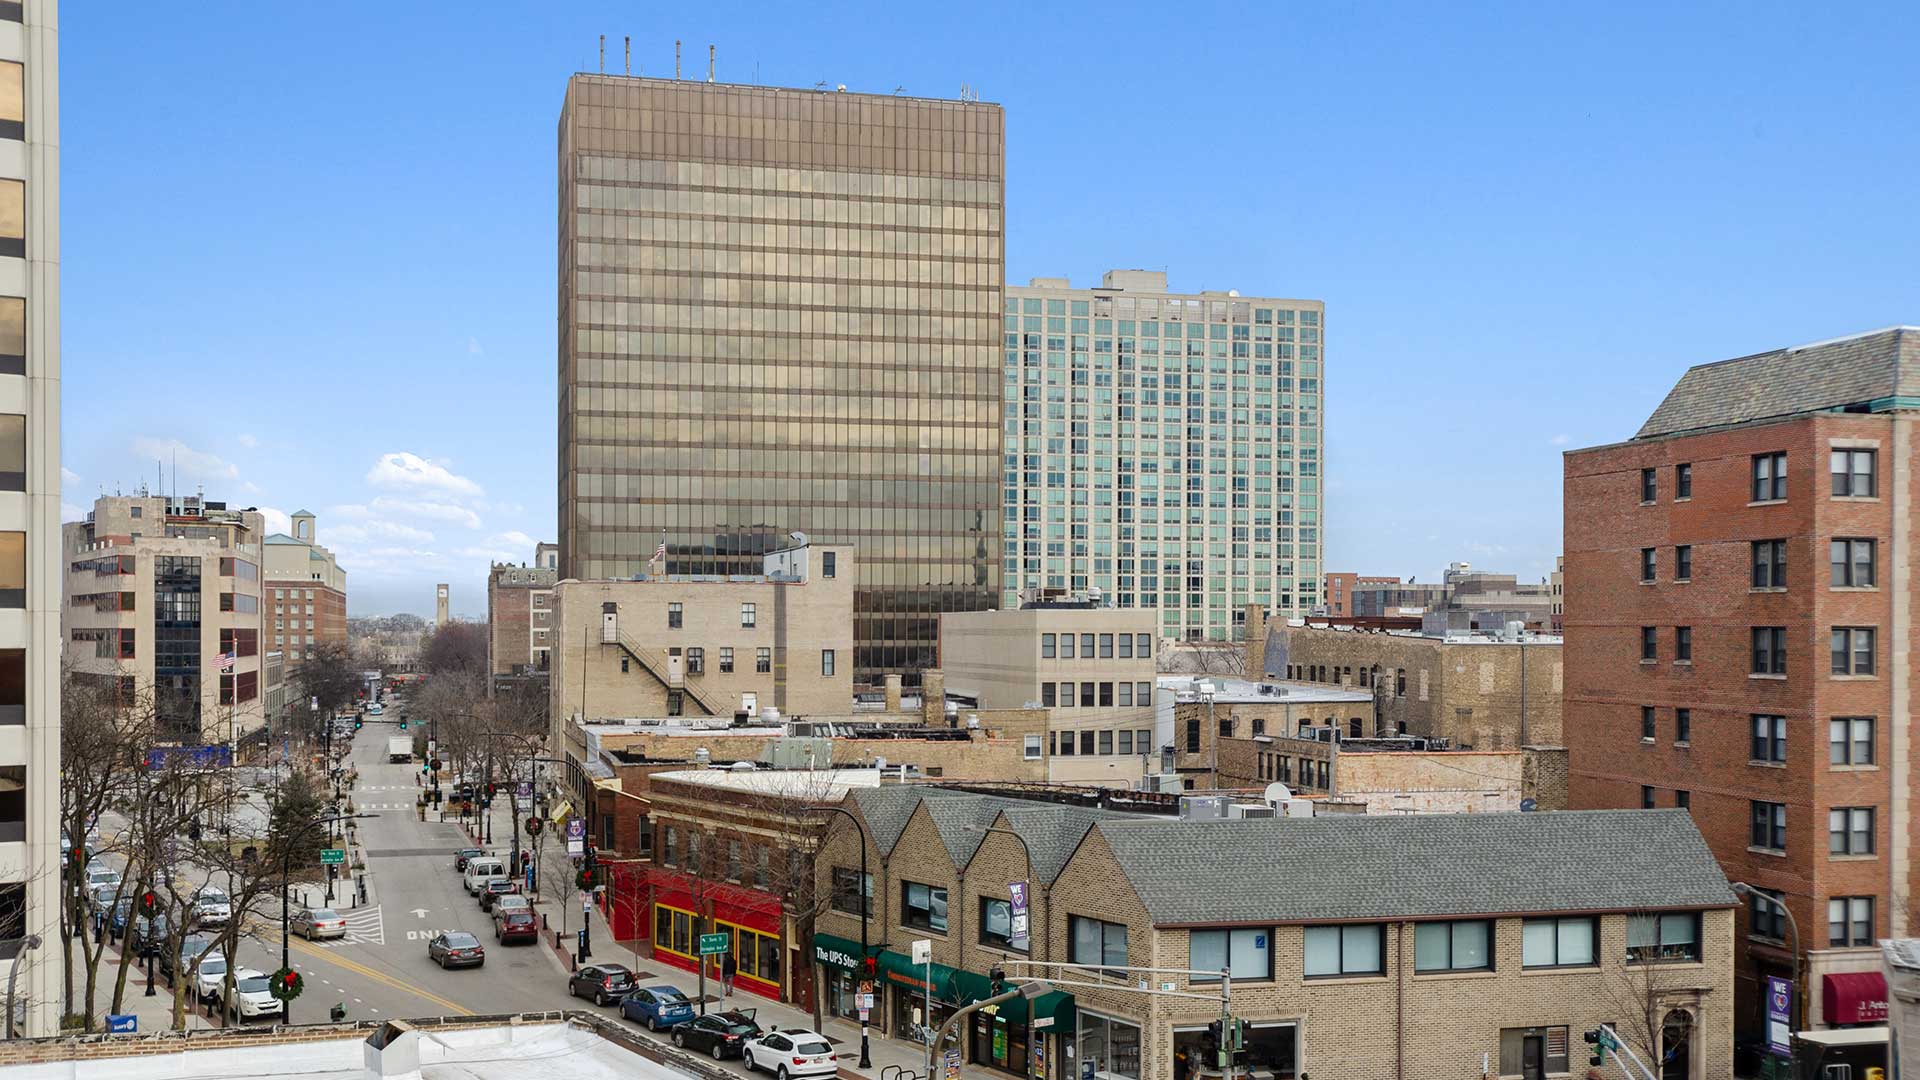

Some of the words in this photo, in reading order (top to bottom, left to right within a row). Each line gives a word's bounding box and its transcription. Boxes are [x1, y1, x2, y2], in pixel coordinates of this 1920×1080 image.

[1010, 883, 1022, 894] WE
[816, 946, 829, 961] The
[829, 949, 843, 965] UPS
[1774, 981, 1787, 994] WE
[971, 998, 1001, 1015] SWAY
